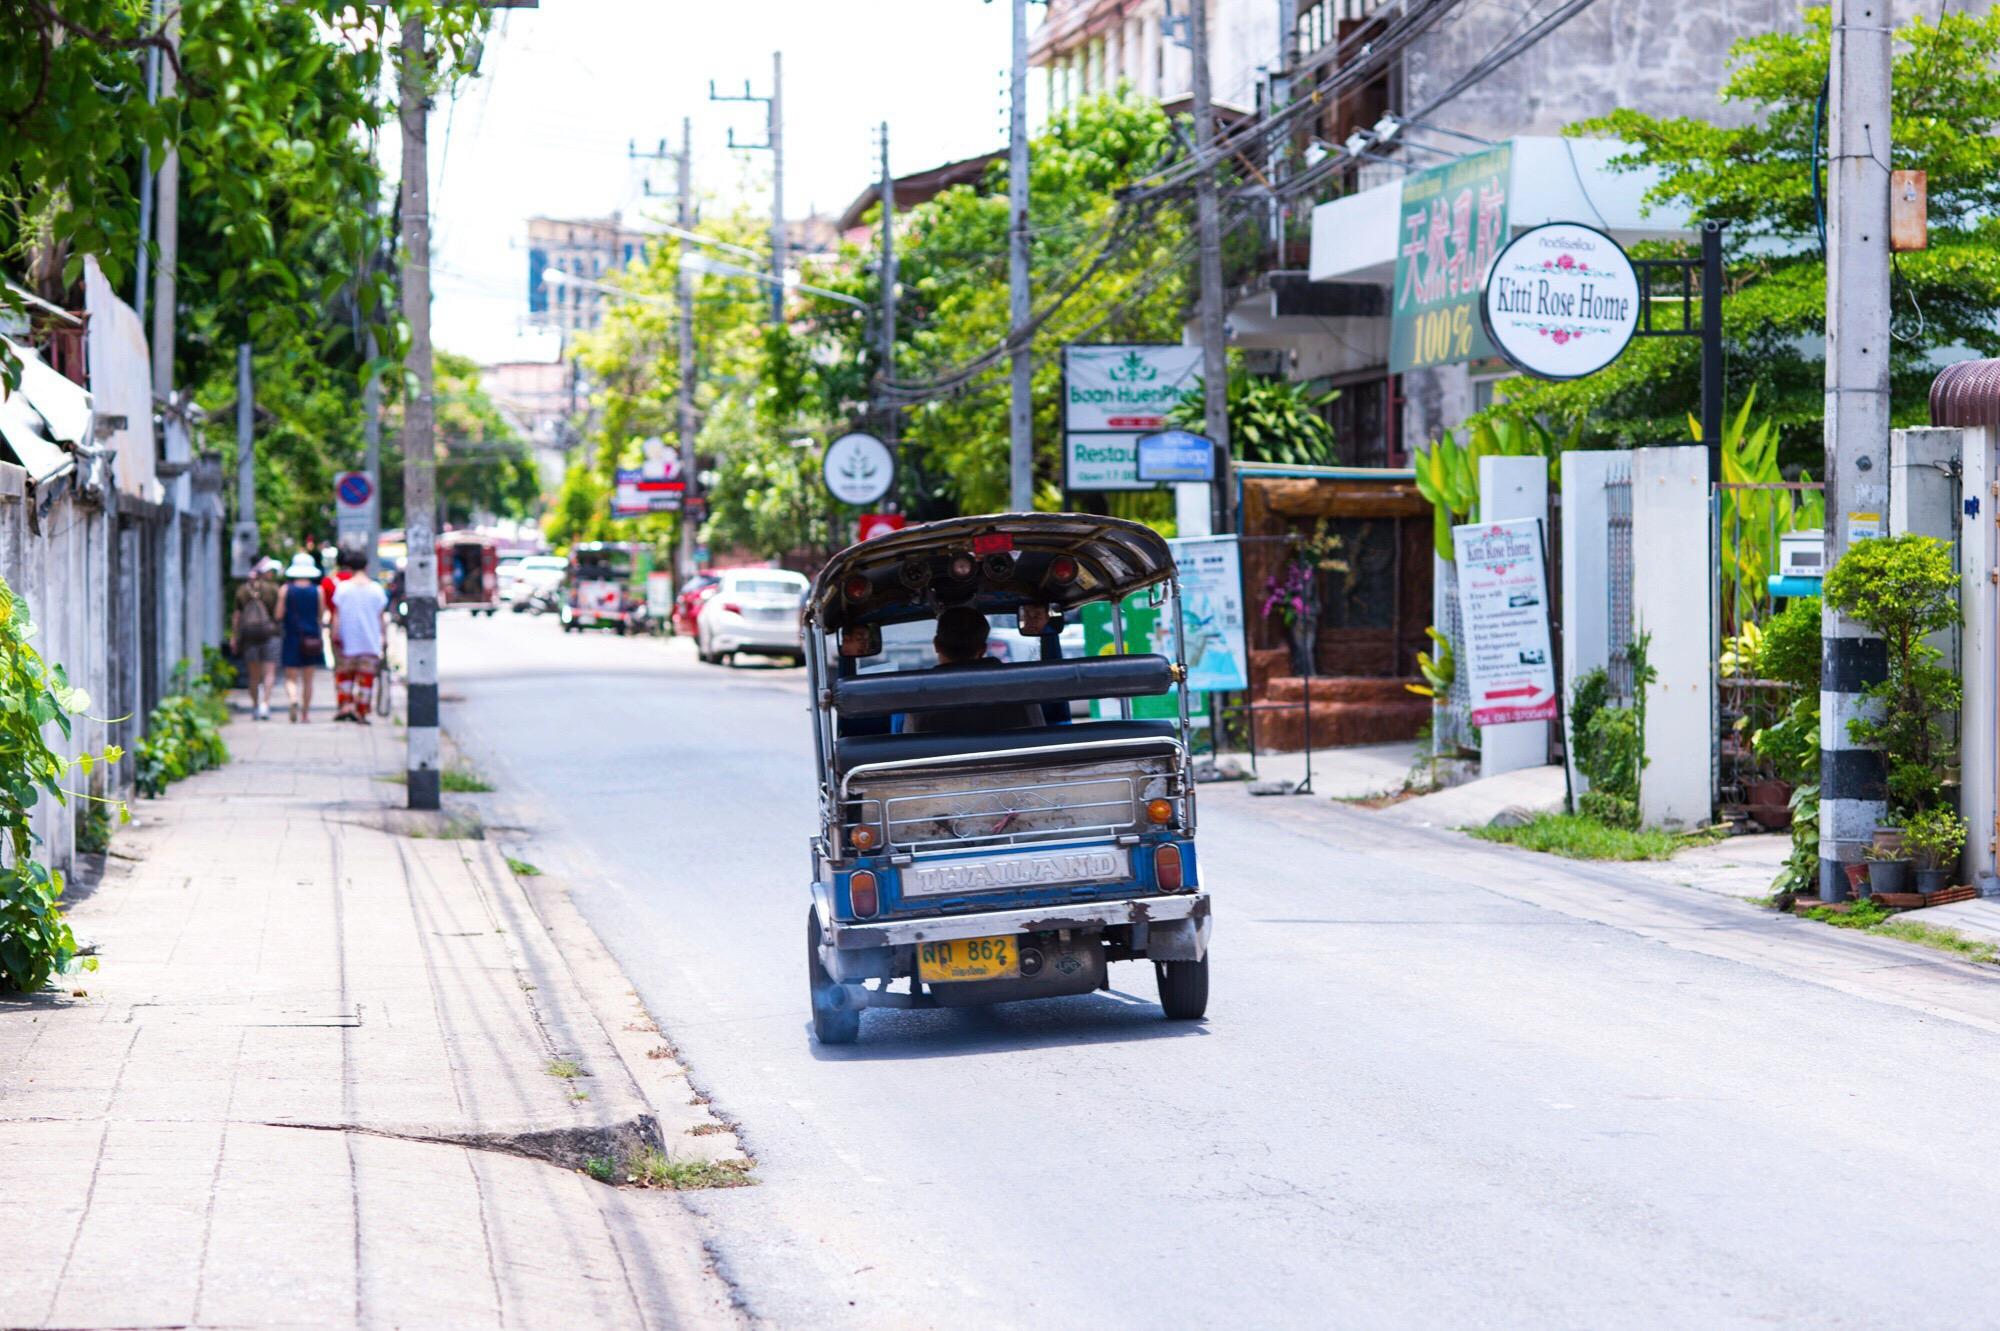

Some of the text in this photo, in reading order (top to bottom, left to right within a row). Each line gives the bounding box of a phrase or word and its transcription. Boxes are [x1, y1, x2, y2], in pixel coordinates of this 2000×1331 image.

[1497, 276, 1629, 321] Kitti Rose Home
[1413, 302, 1472, 366] 100%
[1486, 541, 1504, 559] Rose
[1506, 538, 1531, 557] Home
[917, 852, 1117, 892] THAILAND
[967, 939, 1007, 961] 862
